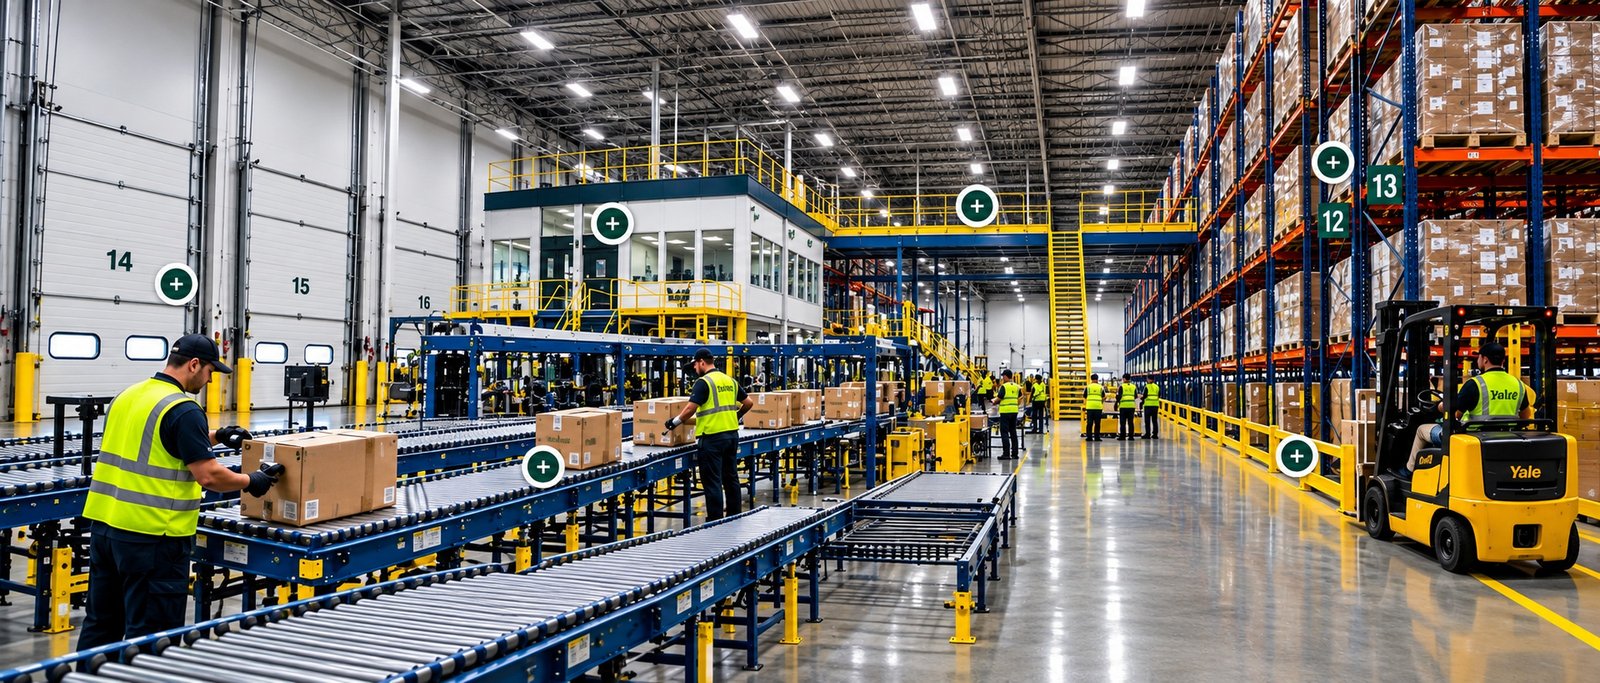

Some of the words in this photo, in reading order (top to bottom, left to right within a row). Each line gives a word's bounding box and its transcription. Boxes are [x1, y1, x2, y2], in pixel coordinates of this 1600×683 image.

[1372, 173, 1398, 198] 13
[1322, 210, 1344, 233] 12
[106, 249, 133, 272] 14
[292, 276, 310, 295] 15
[418, 295, 430, 309] 16
[1510, 465, 1542, 479] Yale
